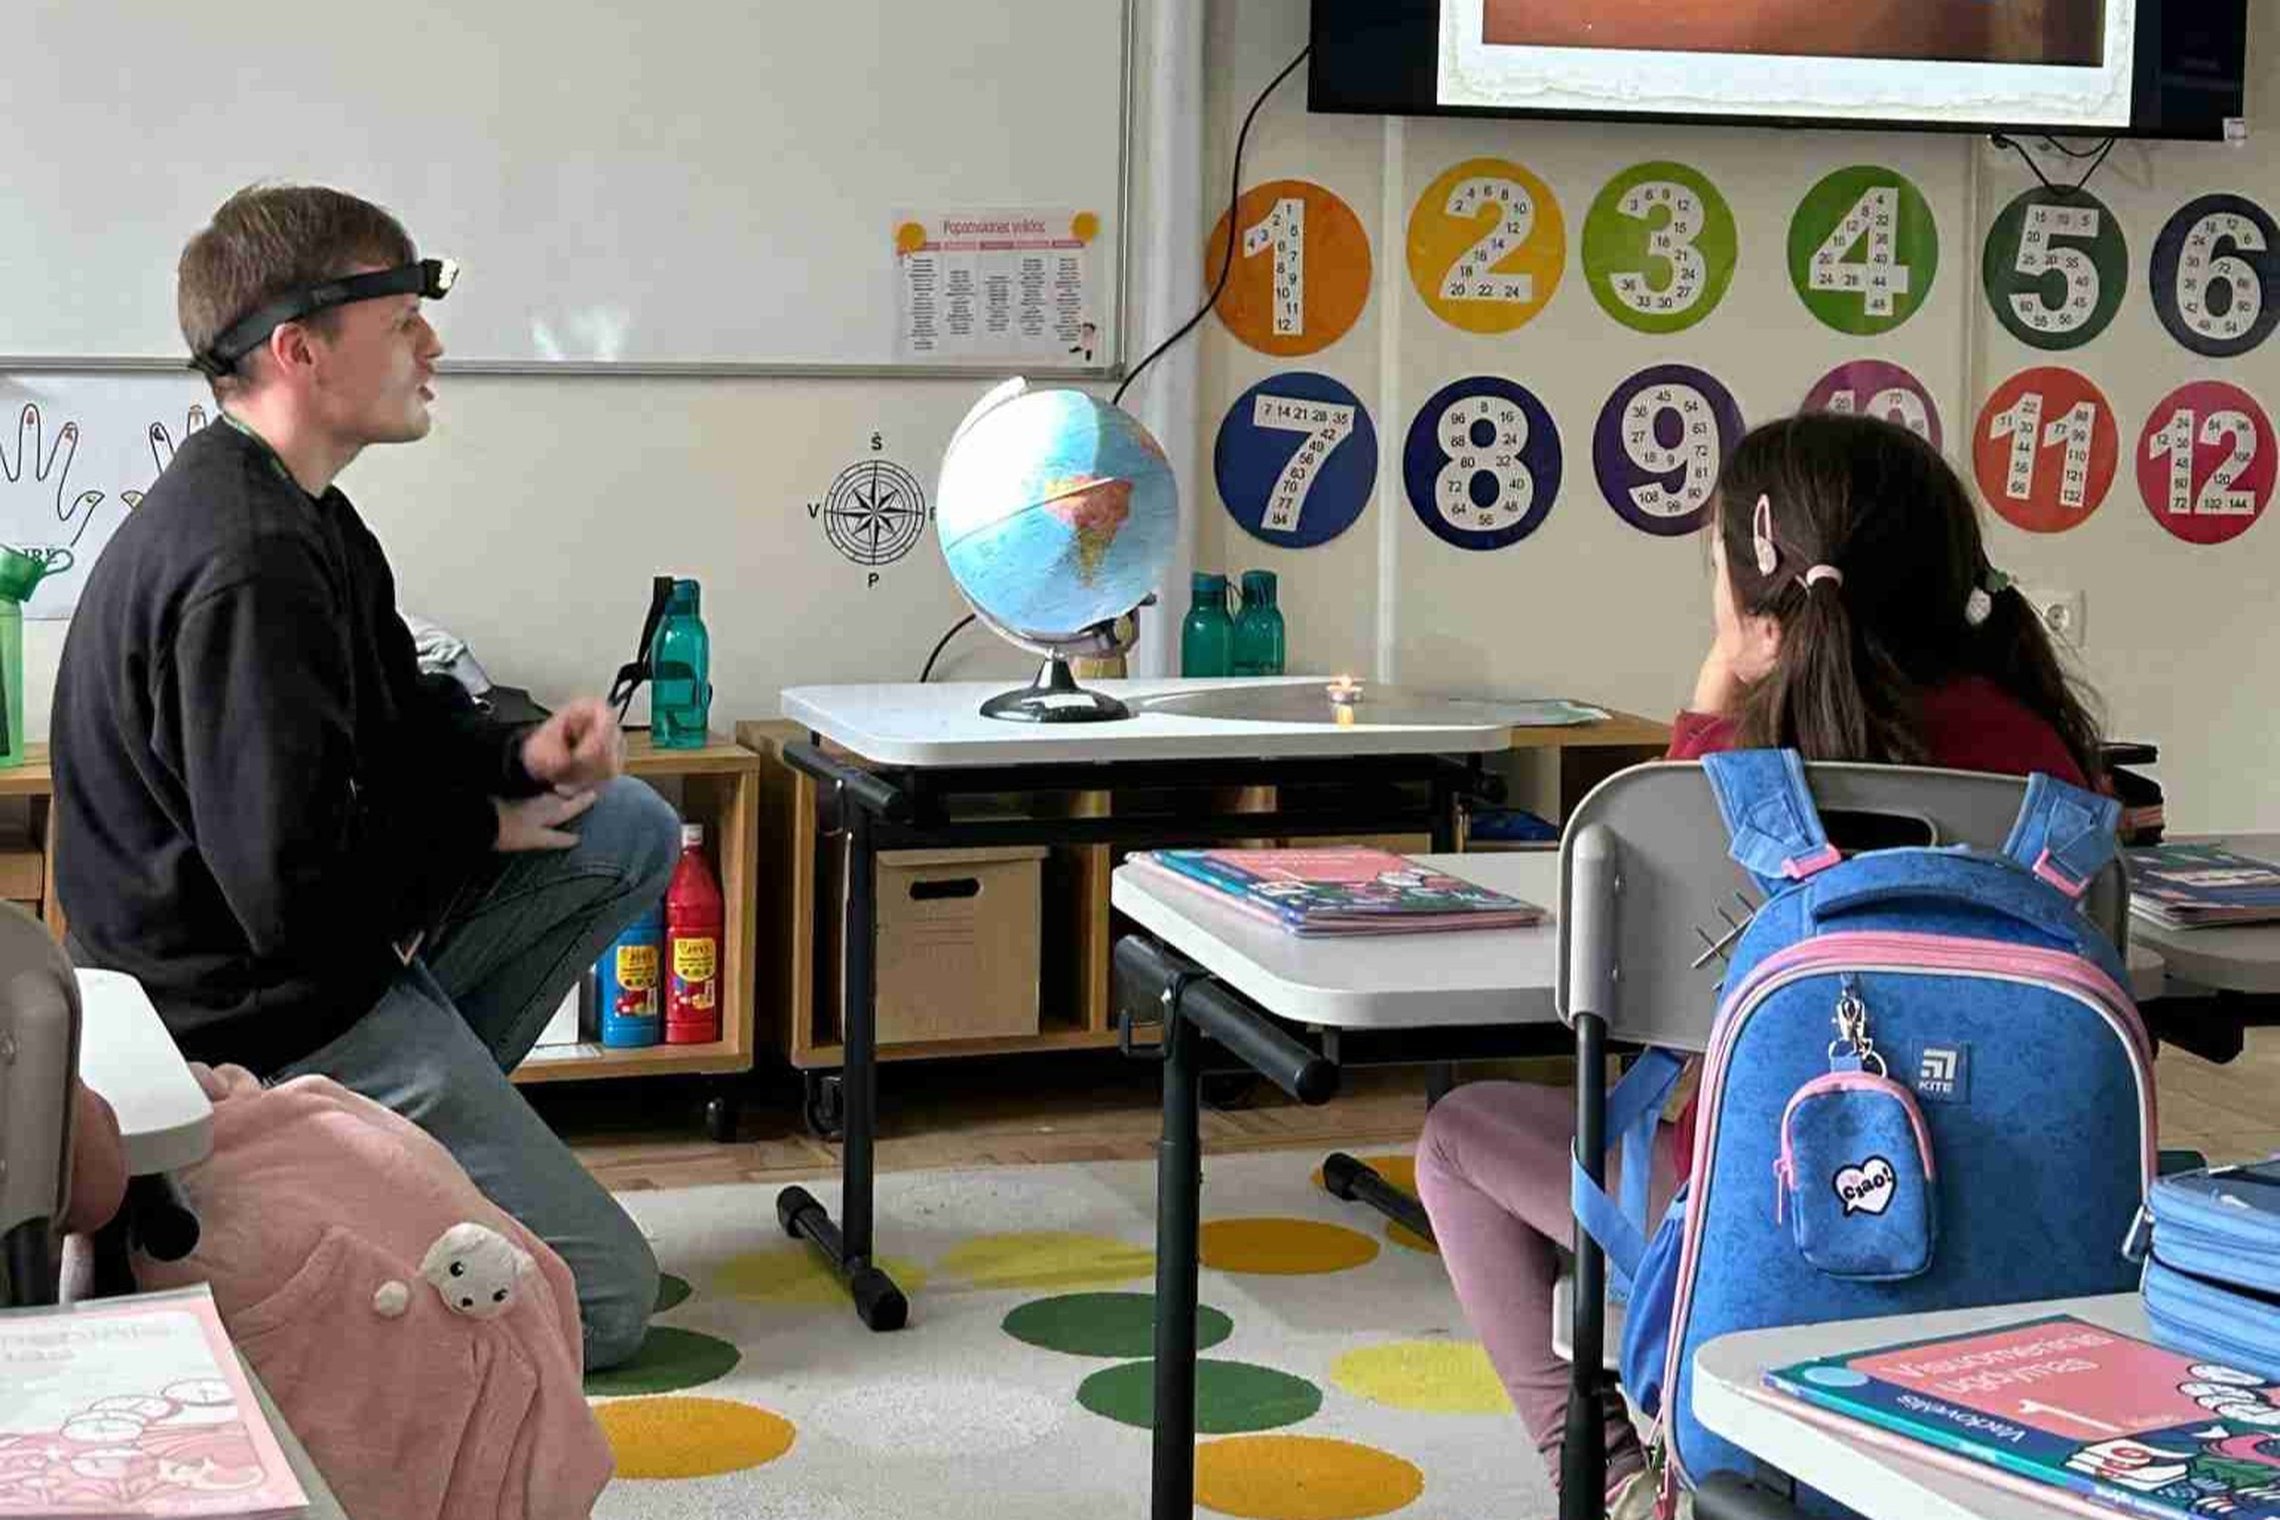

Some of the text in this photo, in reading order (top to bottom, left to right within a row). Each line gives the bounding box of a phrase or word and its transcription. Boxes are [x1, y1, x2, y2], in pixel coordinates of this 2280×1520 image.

[1514, 202, 1527, 214] 10
[1507, 221, 1520, 234] 12
[1674, 222, 1687, 233] 15
[1440, 177, 1533, 302] 2
[1610, 181, 1706, 315] 3
[1809, 186, 1910, 315] 4
[1244, 198, 1304, 334] 1
[2008, 204, 2099, 333] 5
[2177, 212, 2267, 340] 6
[1277, 287, 1290, 298] 10
[1478, 284, 1492, 296] 22
[1505, 285, 1519, 298] 24
[1287, 302, 1297, 314] 11
[1279, 319, 1291, 331] 12
[1264, 404, 1348, 424] 7 14 21 28 35
[1500, 411, 1513, 422] 16
[1320, 428, 1336, 440] 42
[1503, 433, 1517, 445] 24
[1622, 384, 1719, 517] 9
[1990, 392, 2096, 507] 11
[1253, 395, 1355, 532] 7
[1299, 452, 1314, 465] 56
[1435, 395, 1534, 531] 8
[1496, 455, 1510, 467] 32
[2149, 409, 2257, 515] 12
[1290, 467, 1306, 480] 63
[1282, 480, 1297, 493] 70
[1448, 481, 1461, 492] 72
[1509, 478, 1525, 490] 40
[1279, 497, 1293, 509] 77
[1639, 491, 1658, 503] 108
[808, 504, 820, 518] V
[1452, 503, 1466, 514] 64
[868, 573, 879, 587] P
[1919, 1081, 1953, 1092] KITE
